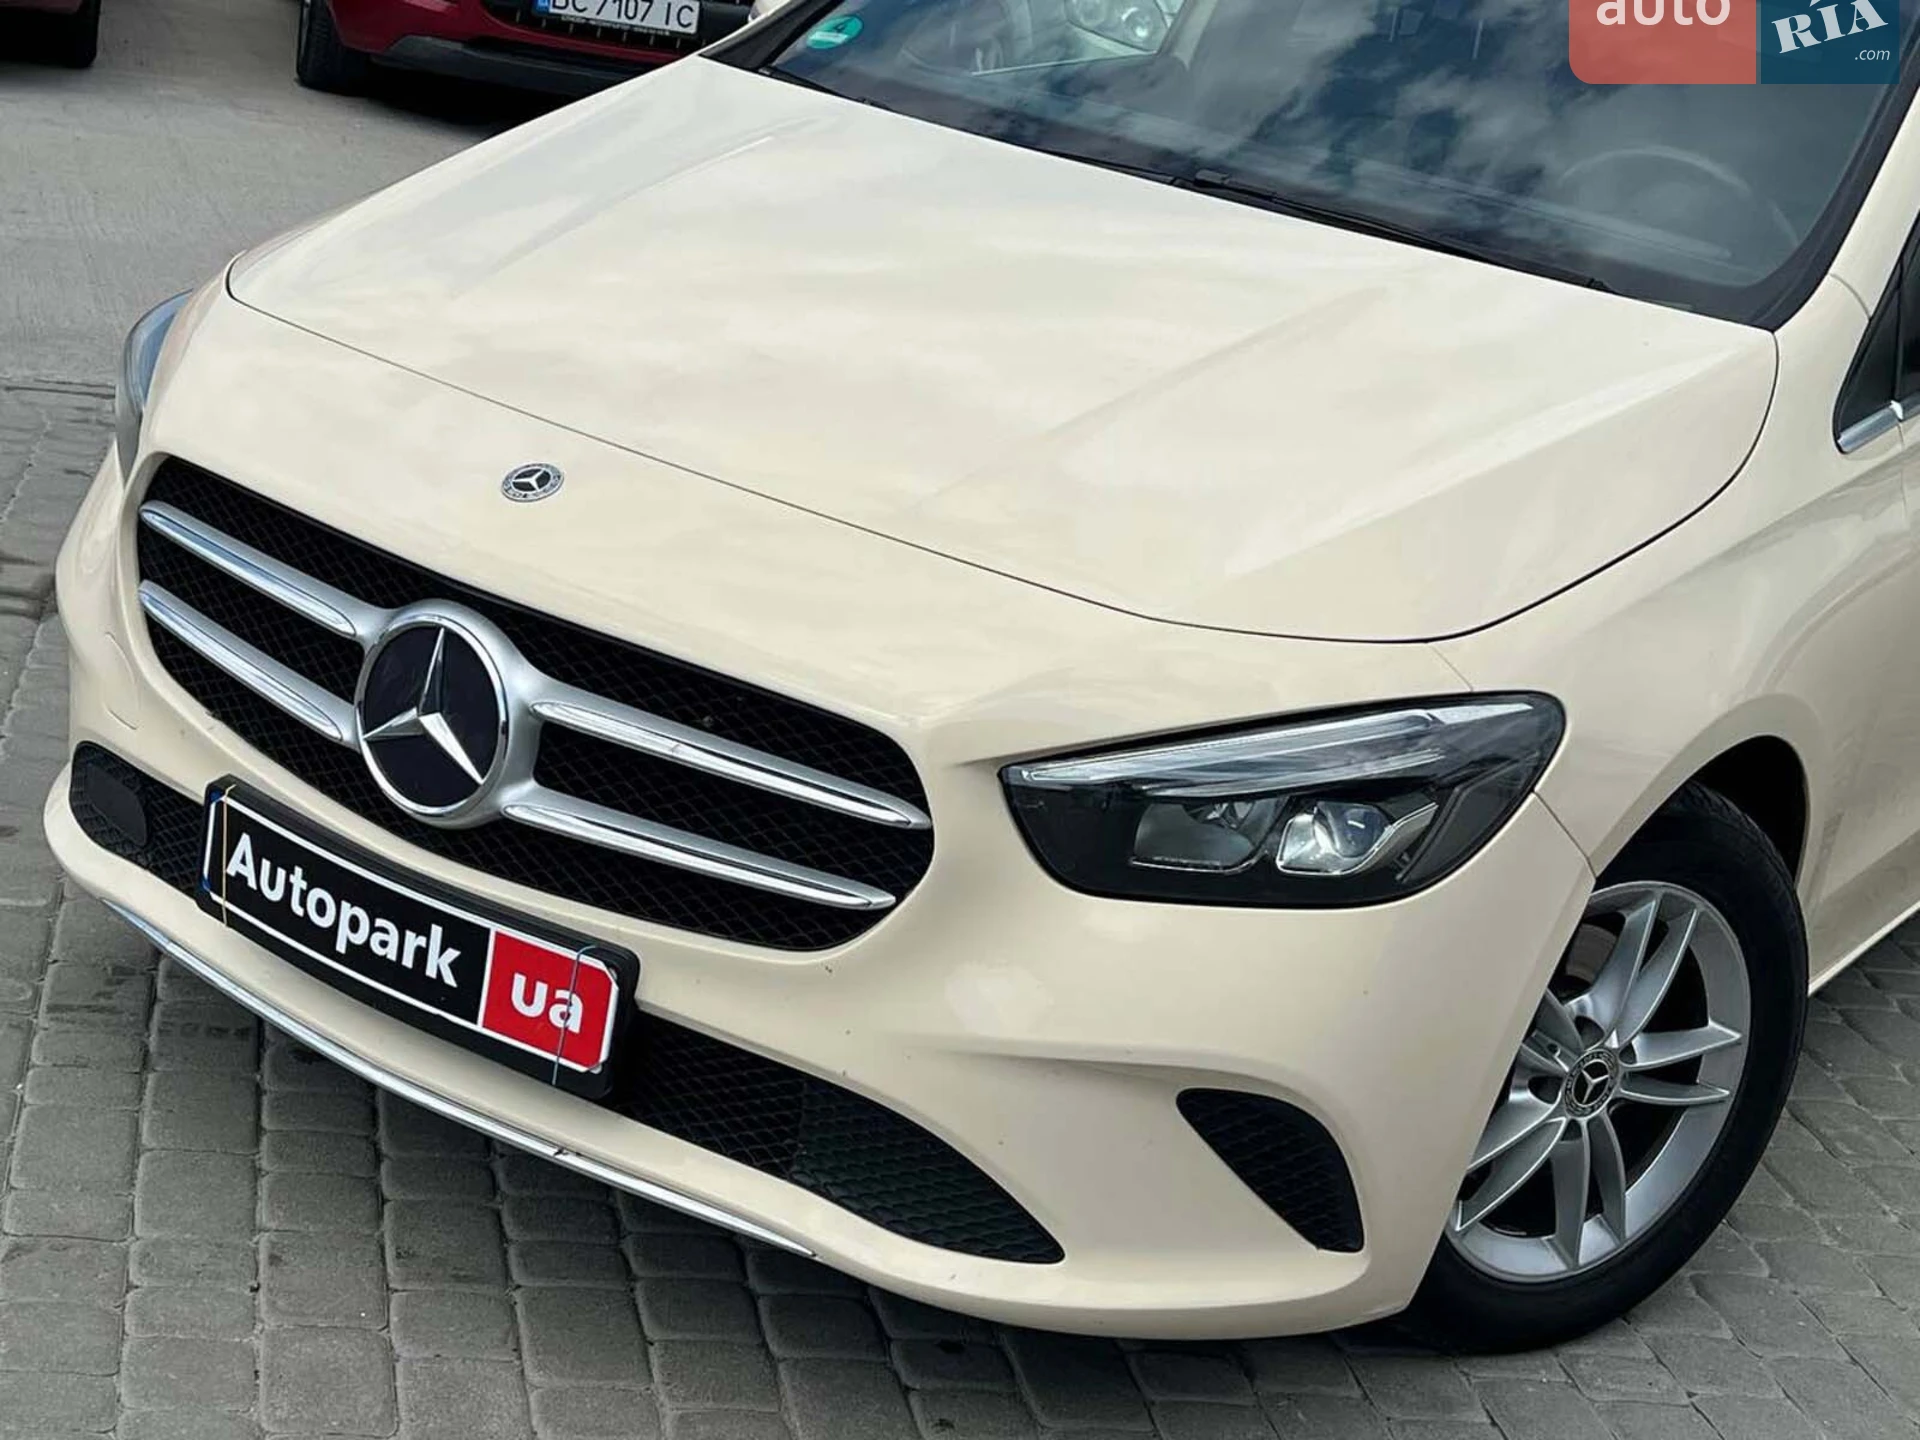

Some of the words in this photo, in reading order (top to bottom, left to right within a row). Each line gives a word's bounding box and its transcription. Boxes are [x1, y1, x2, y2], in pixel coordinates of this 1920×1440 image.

[596, 0, 653, 23] 7107
[665, 2, 694, 28] IC
[226, 832, 461, 988] Autopark
[511, 972, 584, 1034] ua
